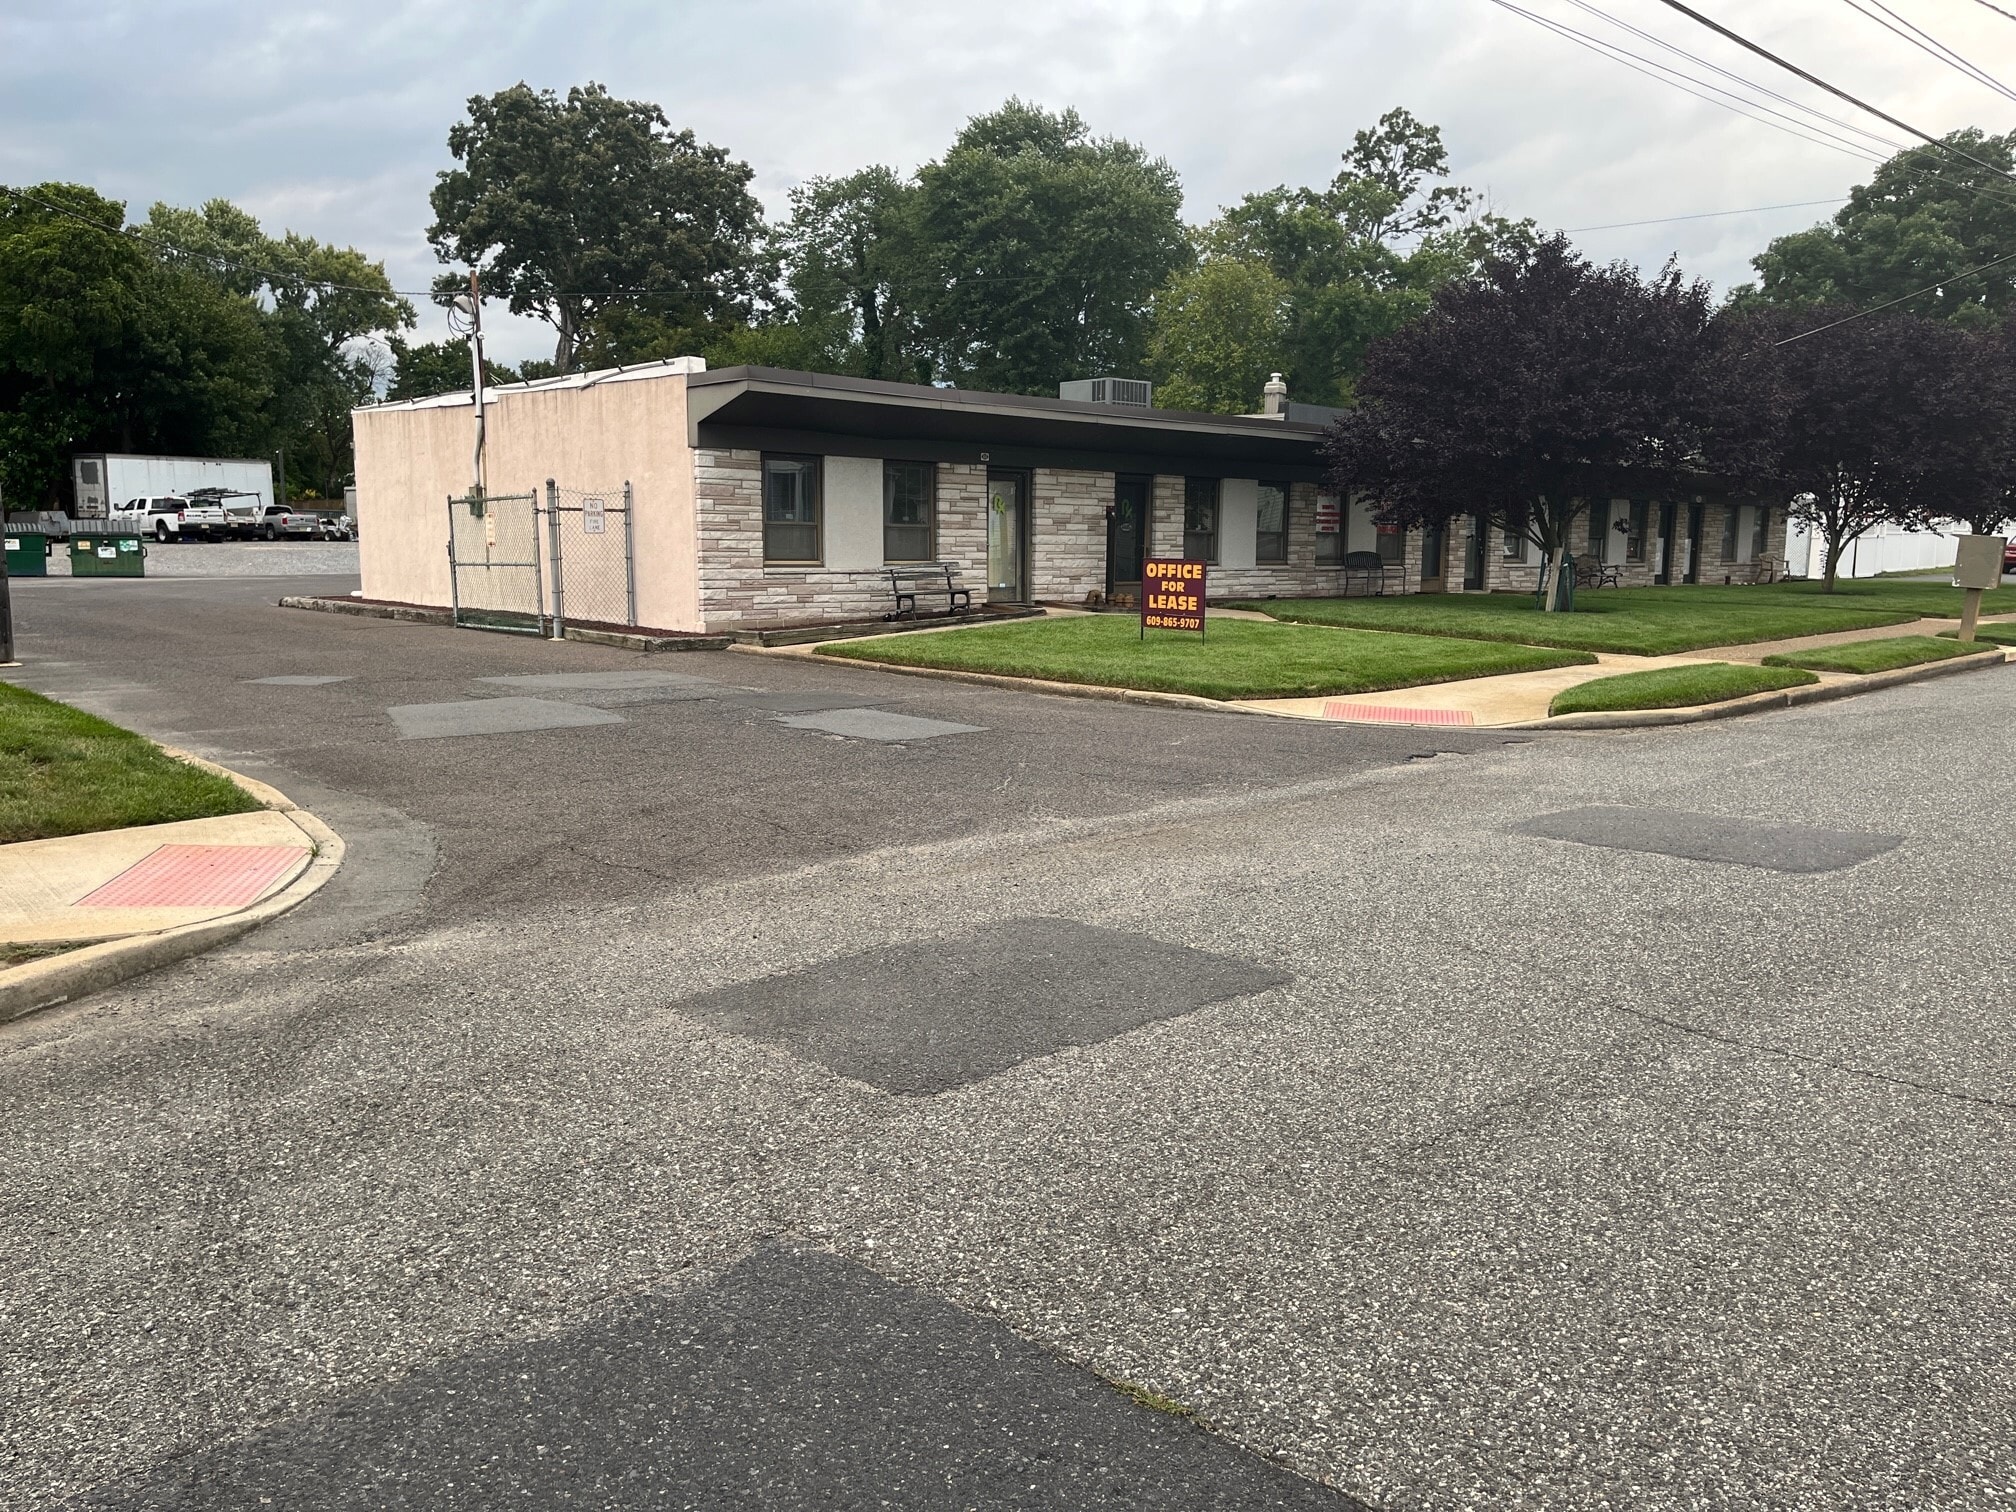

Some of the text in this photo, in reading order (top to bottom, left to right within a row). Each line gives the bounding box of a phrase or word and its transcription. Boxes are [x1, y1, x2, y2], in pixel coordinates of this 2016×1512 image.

[1146, 562, 1202, 578] OFFICE
[1161, 580, 1185, 593] FOR
[1148, 594, 1197, 610] LEASE
[1146, 615, 1199, 628] 609-865-9707
